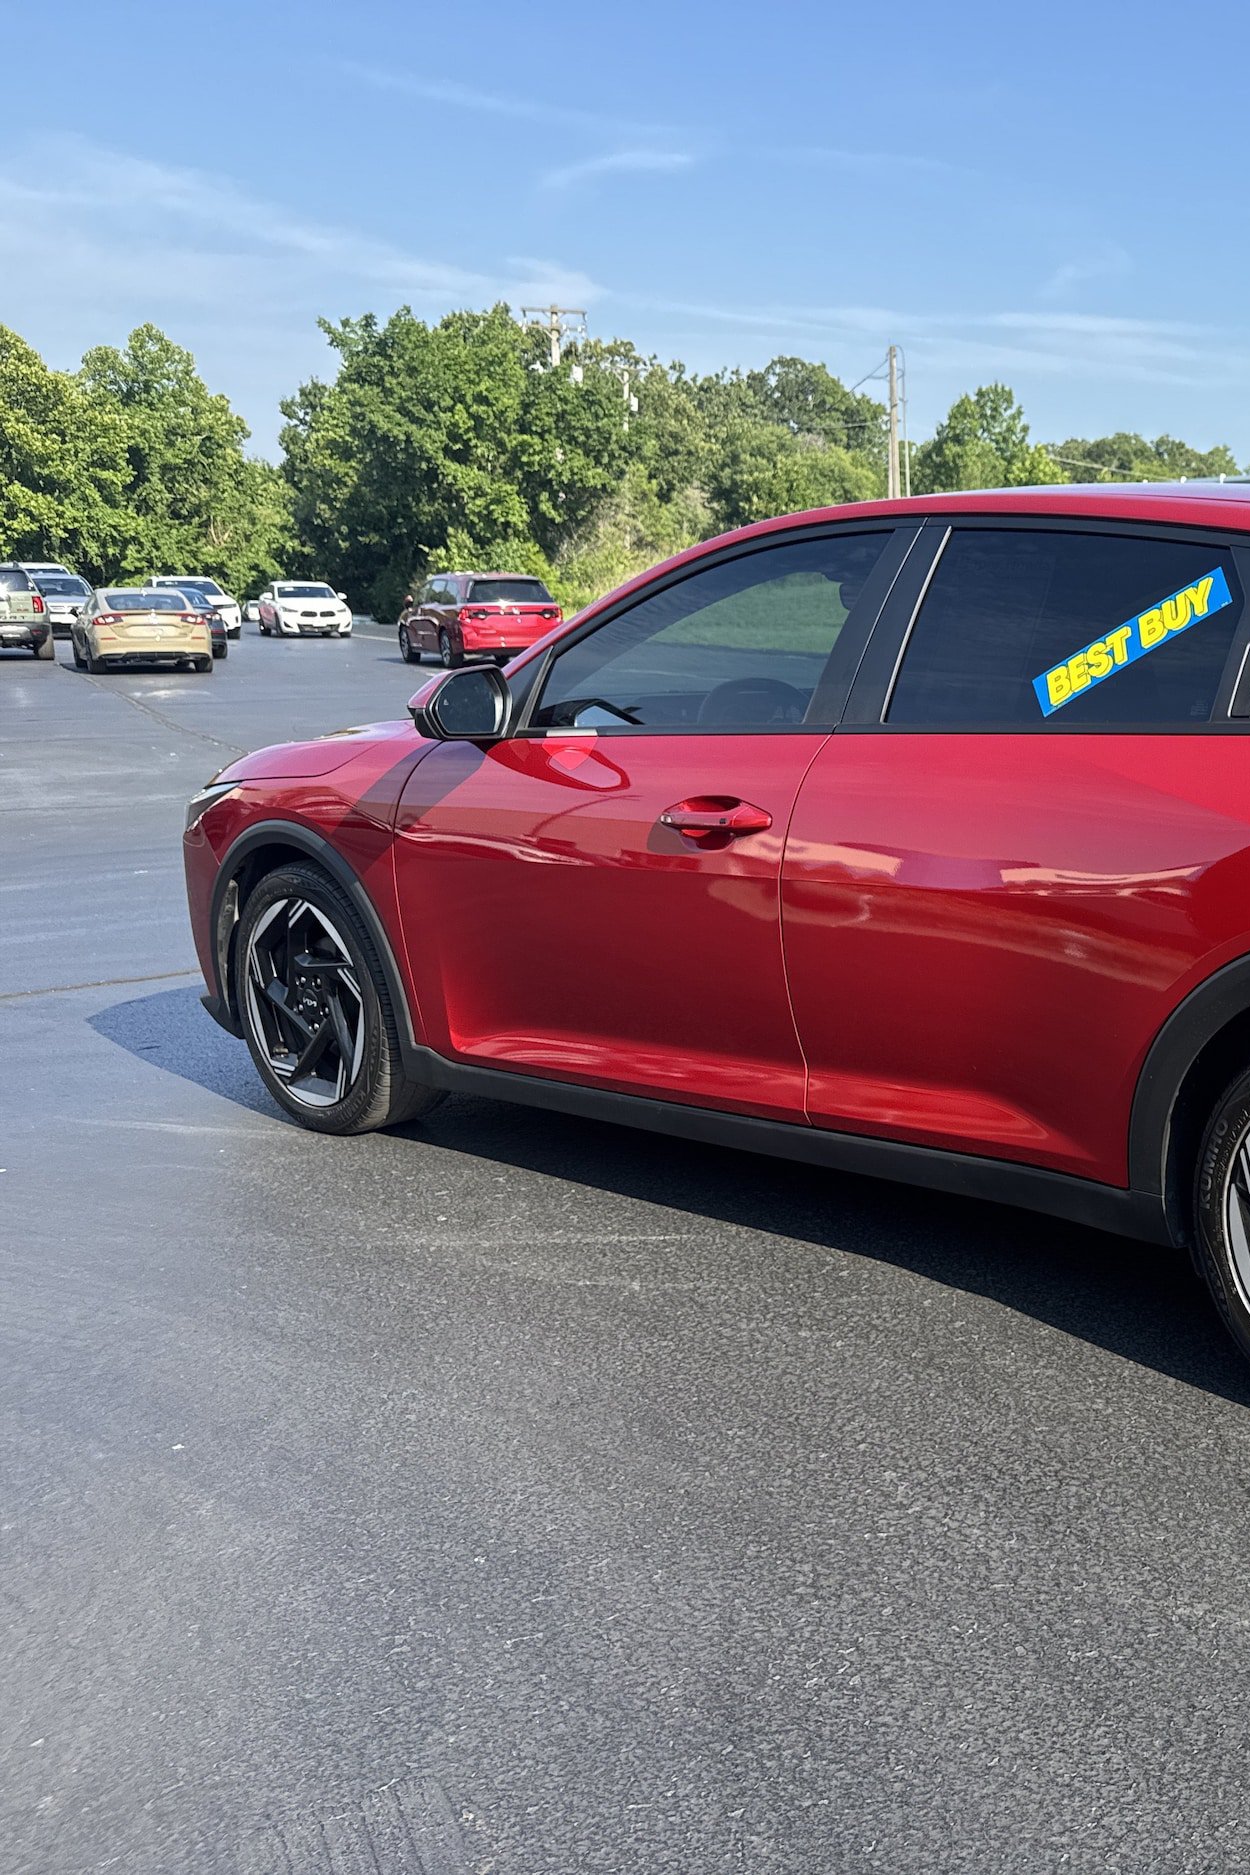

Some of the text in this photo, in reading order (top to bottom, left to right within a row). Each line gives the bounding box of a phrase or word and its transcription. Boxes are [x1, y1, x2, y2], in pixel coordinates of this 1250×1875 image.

[1046, 577, 1214, 706] BEST BUY
[1202, 1119, 1229, 1210] KUMHO
